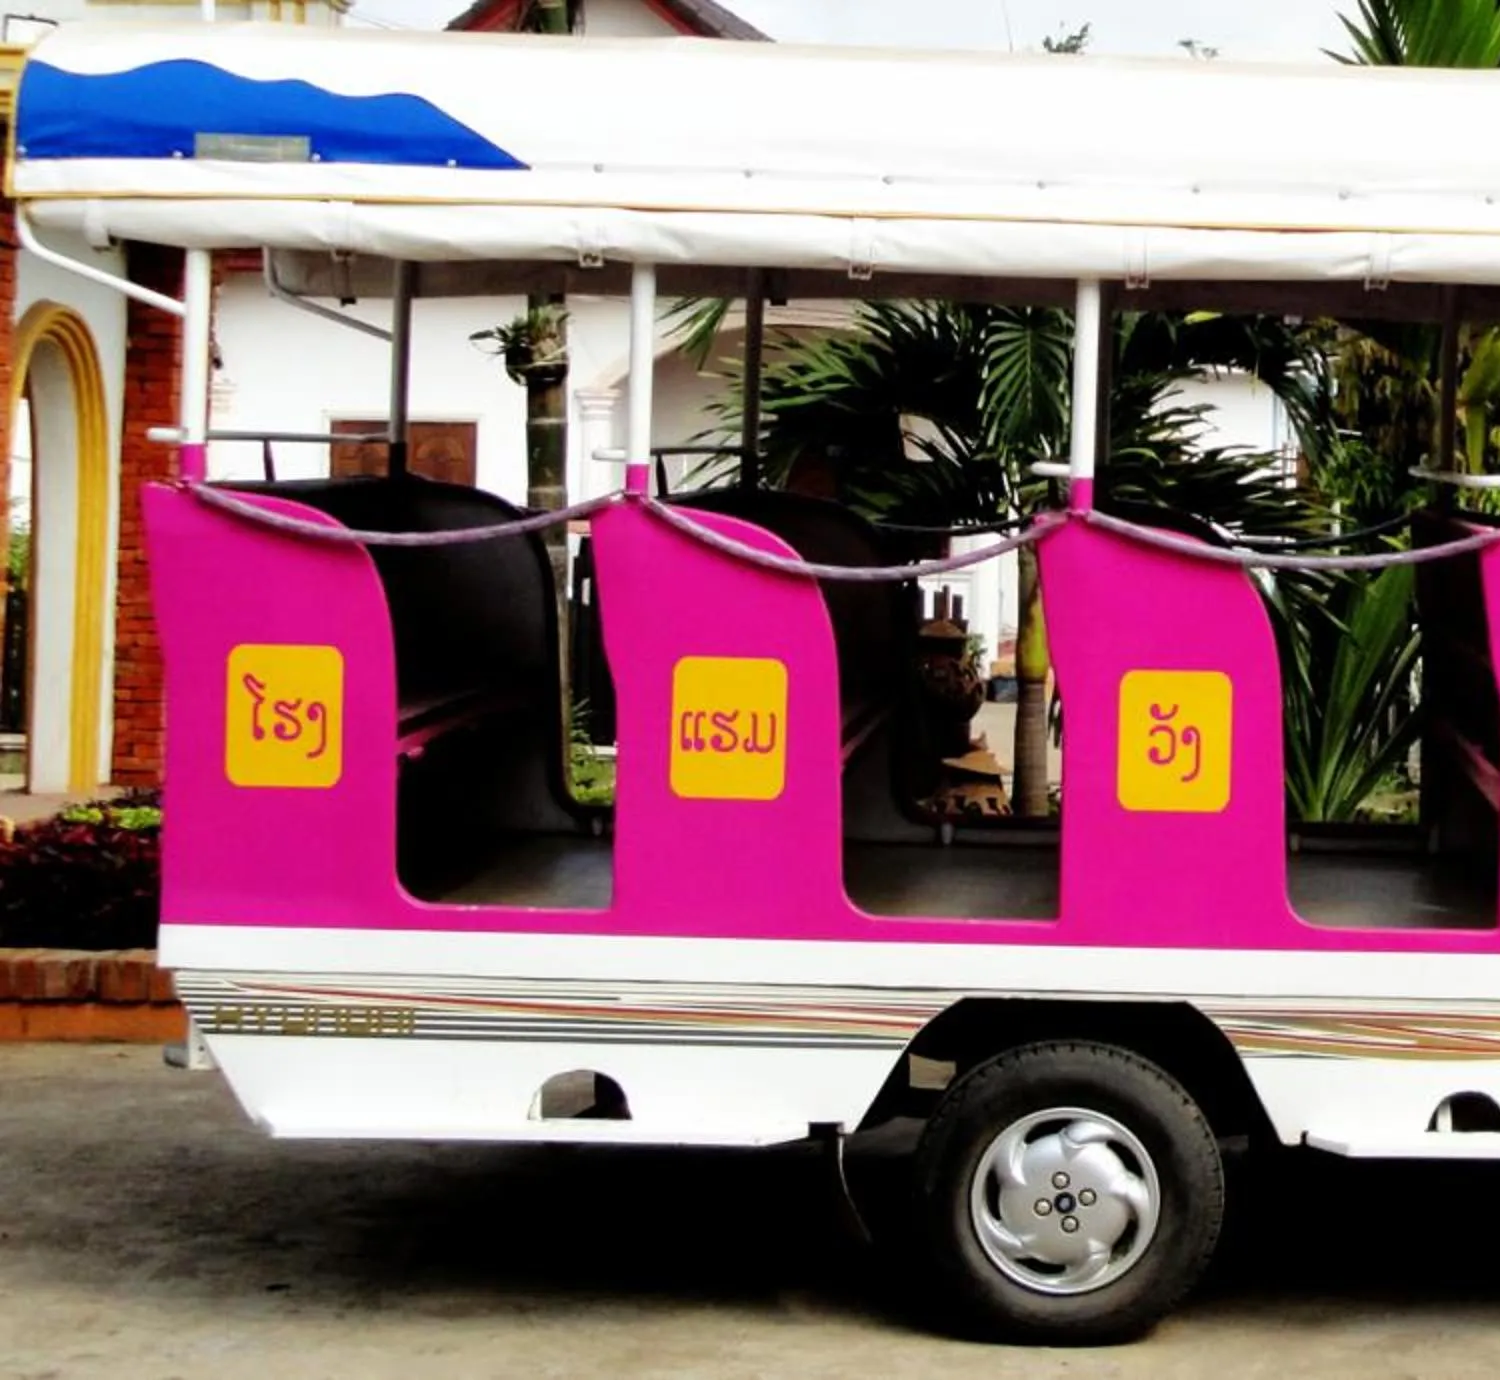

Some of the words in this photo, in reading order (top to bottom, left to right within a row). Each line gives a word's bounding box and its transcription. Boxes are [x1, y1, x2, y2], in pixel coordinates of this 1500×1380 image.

[242, 672, 327, 758] ໂຮງ
[680, 709, 777, 753] ແຮມ
[1148, 702, 1201, 783] ວັງ
